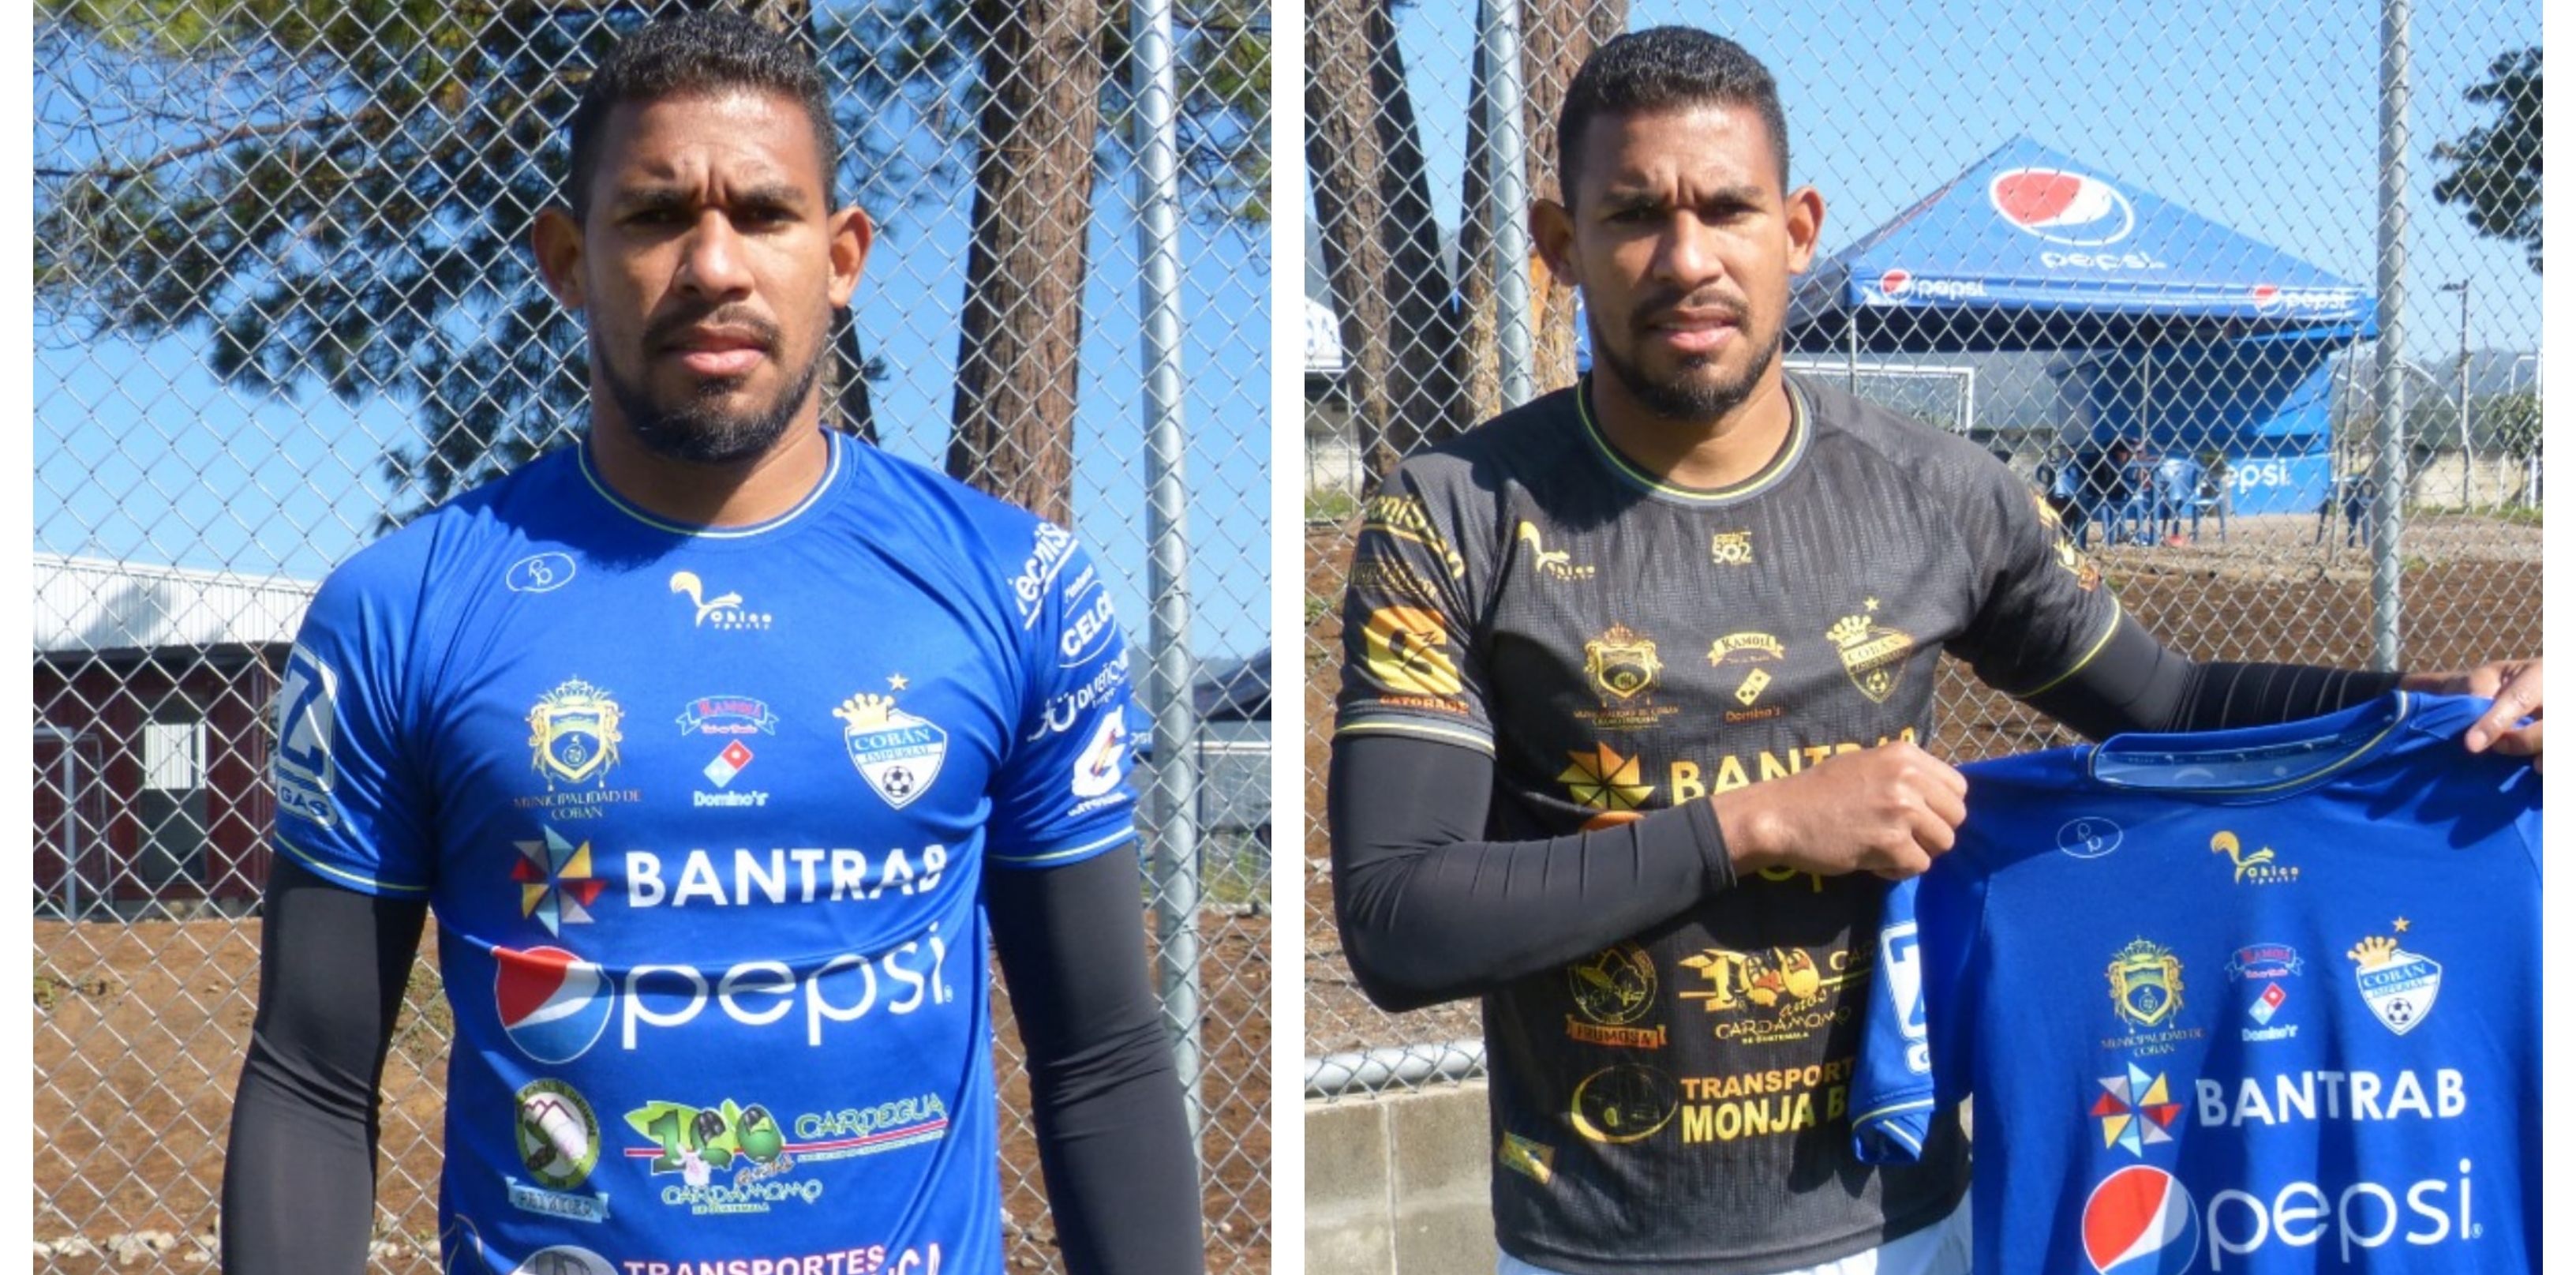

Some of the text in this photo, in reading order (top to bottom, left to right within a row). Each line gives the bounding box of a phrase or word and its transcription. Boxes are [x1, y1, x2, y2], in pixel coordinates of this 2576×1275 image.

[2041, 249, 2167, 271] pepsi
[1917, 279, 1987, 301] pepsi
[2226, 457, 2289, 494] epsi
[1725, 707, 1780, 723] Domino's
[280, 786, 330, 819] GAS
[693, 789, 770, 807] Domino's
[625, 844, 947, 908] BANTRAB
[622, 921, 947, 1051] pepsi
[1680, 1056, 1857, 1101] TRANSPORT
[2196, 1068, 2467, 1128] BANTRAB
[794, 1092, 948, 1139] CARDEGUA
[1682, 1092, 1816, 1144] MONJA
[661, 1179, 823, 1206] CARDAMOMO
[2207, 1157, 2473, 1273] pepsi
